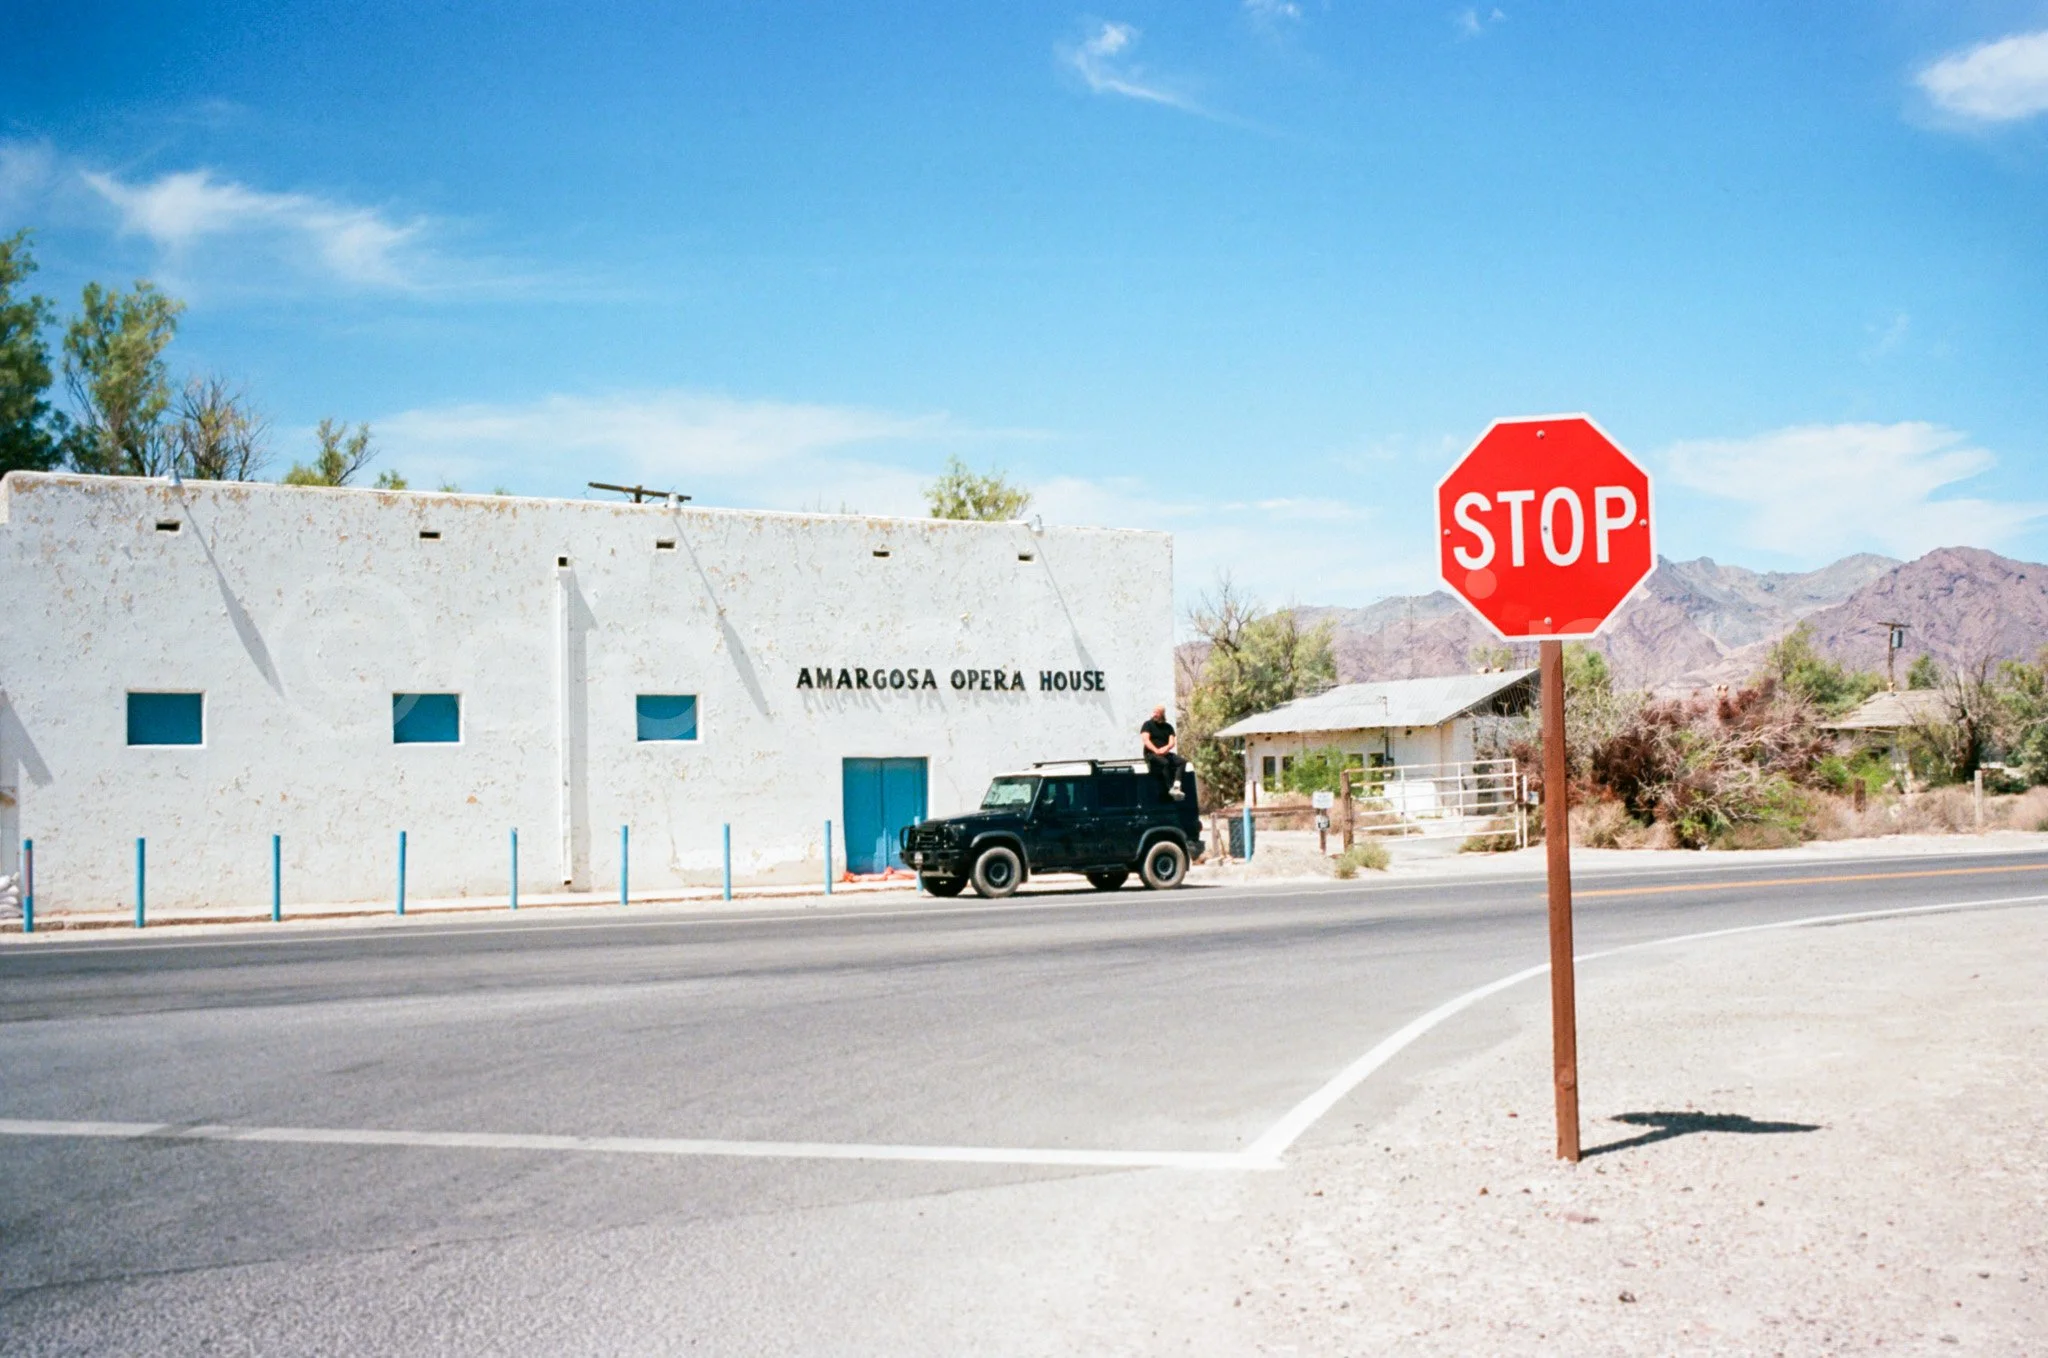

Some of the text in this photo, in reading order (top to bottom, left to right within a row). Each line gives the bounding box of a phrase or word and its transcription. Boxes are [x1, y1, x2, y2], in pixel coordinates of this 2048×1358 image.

[1453, 485, 1637, 571] STOP
[796, 667, 1106, 692] AMARGOSA OPERA HOUSE
